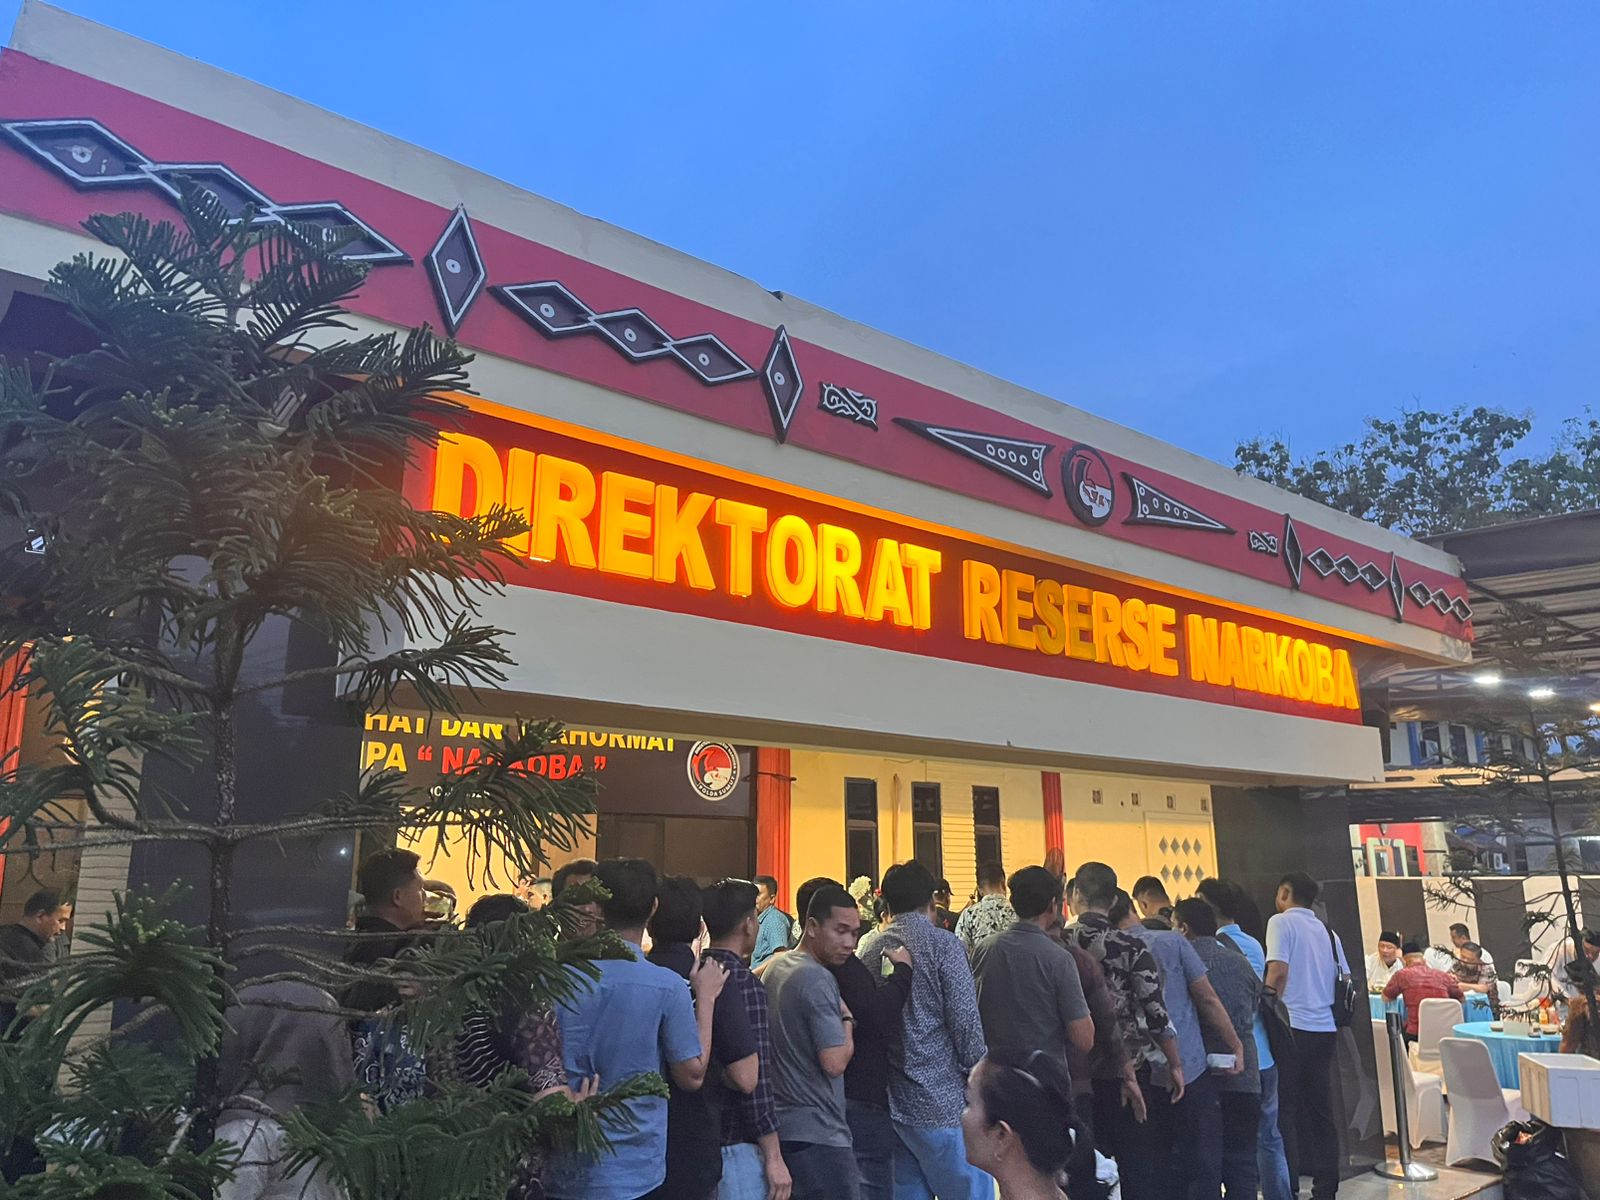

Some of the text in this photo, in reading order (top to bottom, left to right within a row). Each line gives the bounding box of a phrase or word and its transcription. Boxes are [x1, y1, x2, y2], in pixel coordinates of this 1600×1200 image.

[432, 431, 1360, 710] DIREKTORAT RESERSE NARKOBA
[360, 741, 408, 772] PA
[442, 745, 583, 780] NAOBA
